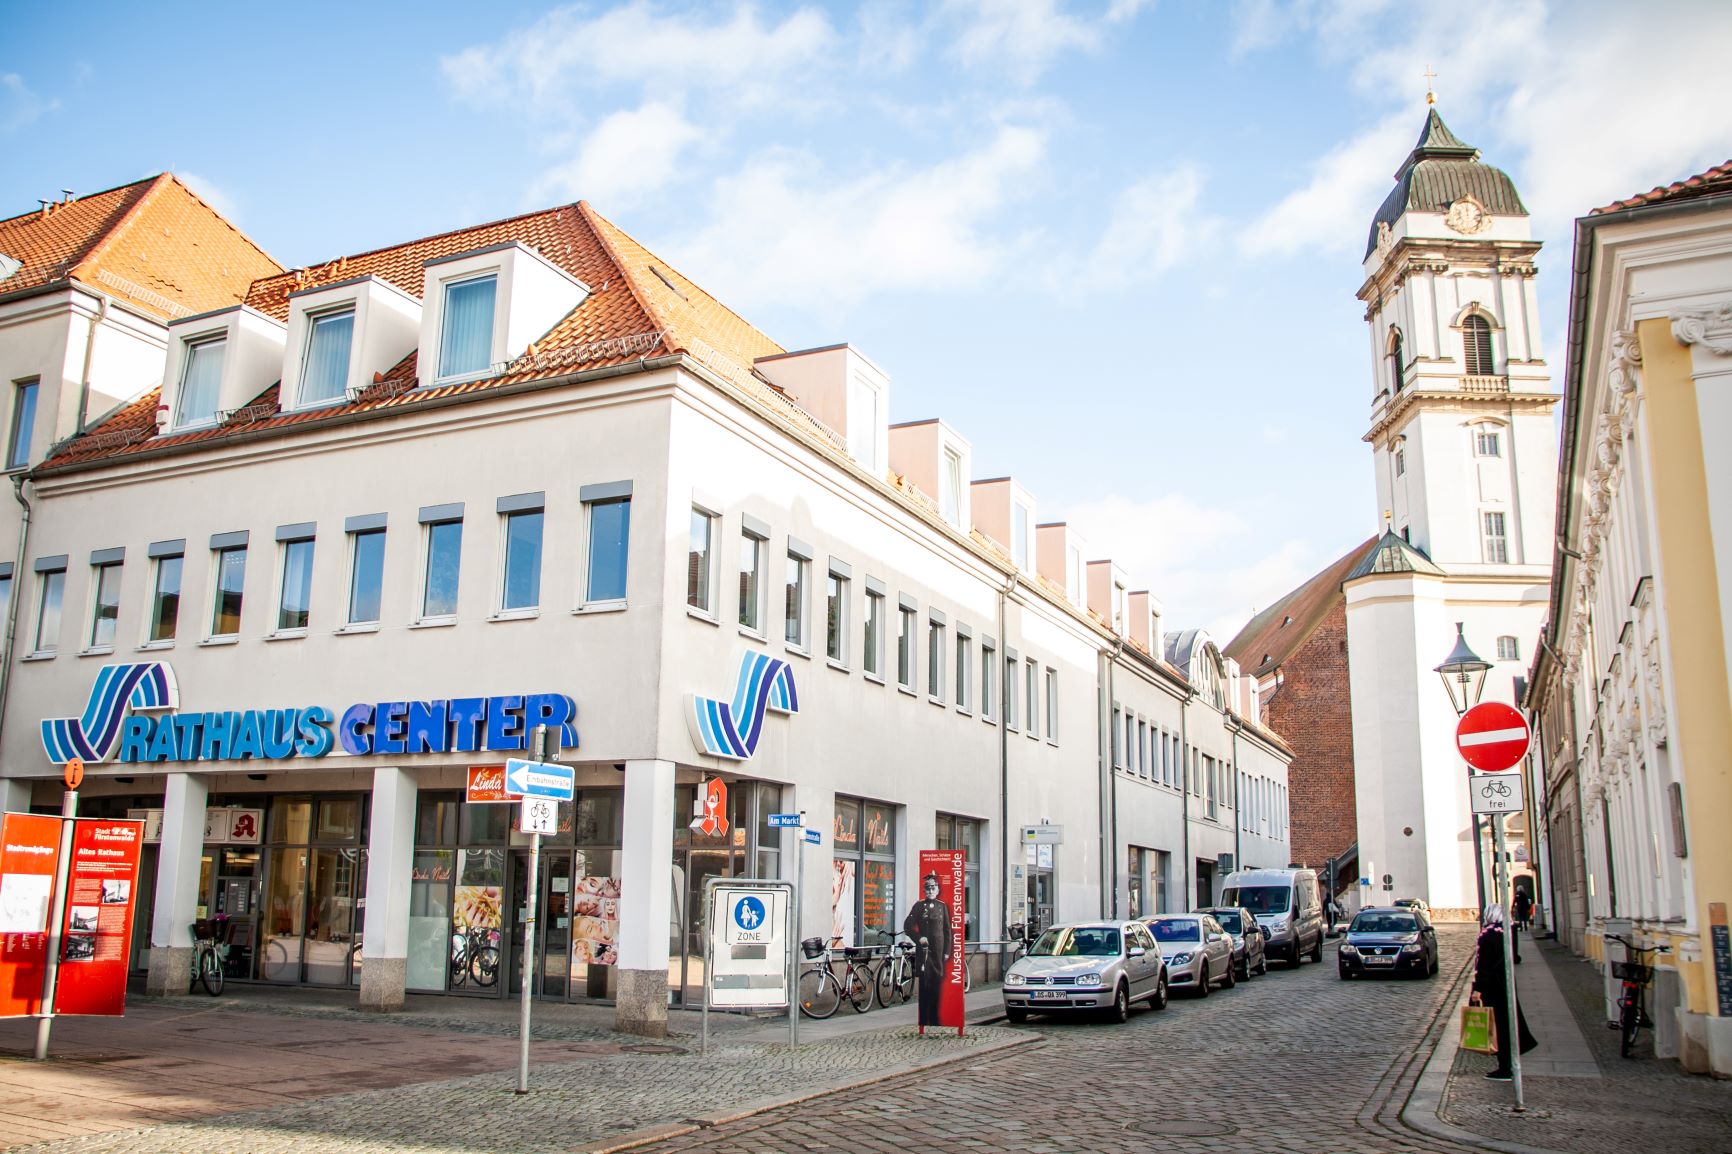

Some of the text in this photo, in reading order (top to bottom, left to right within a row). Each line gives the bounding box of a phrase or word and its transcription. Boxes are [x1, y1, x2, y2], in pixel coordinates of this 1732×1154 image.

[120, 693, 579, 762] RATHAUS CENTER
[470, 772, 502, 791] Linda
[1489, 800, 1506, 808] frei
[769, 816, 799, 824] Am Markt
[78, 848, 125, 857] Altes Rathaus
[951, 852, 963, 984] Museum Fürstenwalde
[737, 932, 761, 941] ZONE
